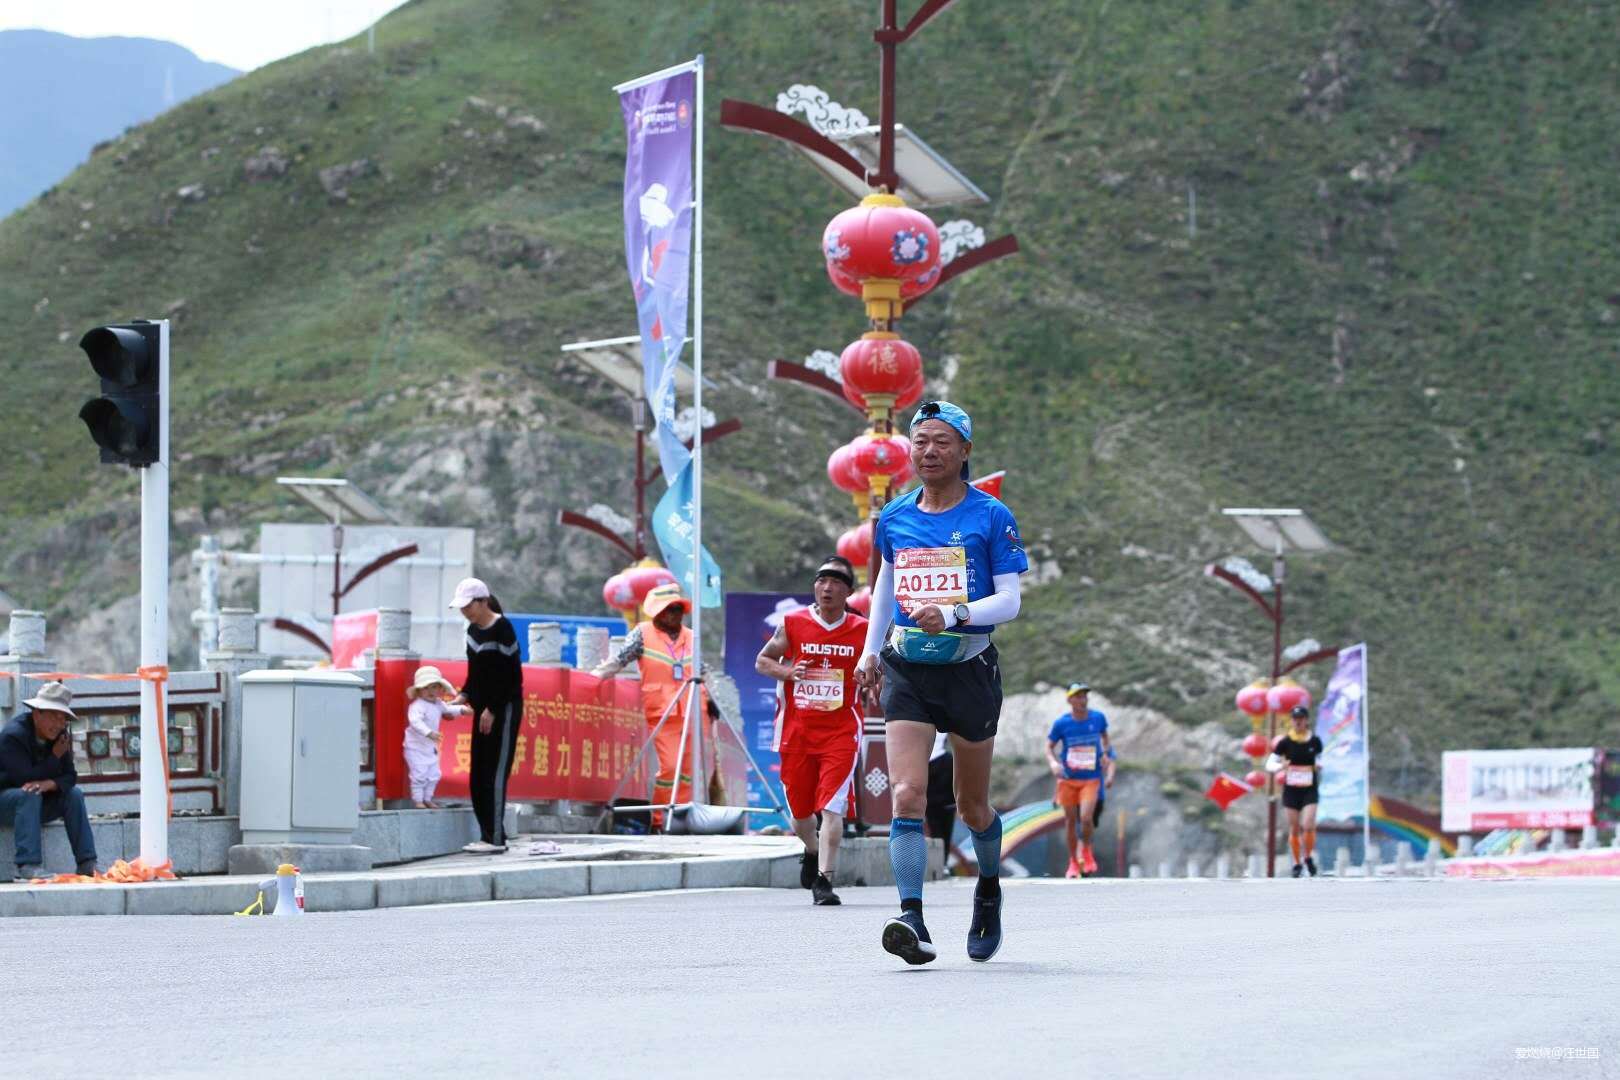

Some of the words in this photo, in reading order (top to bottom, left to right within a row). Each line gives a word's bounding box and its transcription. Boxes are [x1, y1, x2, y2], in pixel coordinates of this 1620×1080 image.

[868, 345, 898, 375] 德
[897, 573, 962, 592] A0121
[800, 643, 855, 657] HOUSTON
[797, 684, 840, 697] A0176
